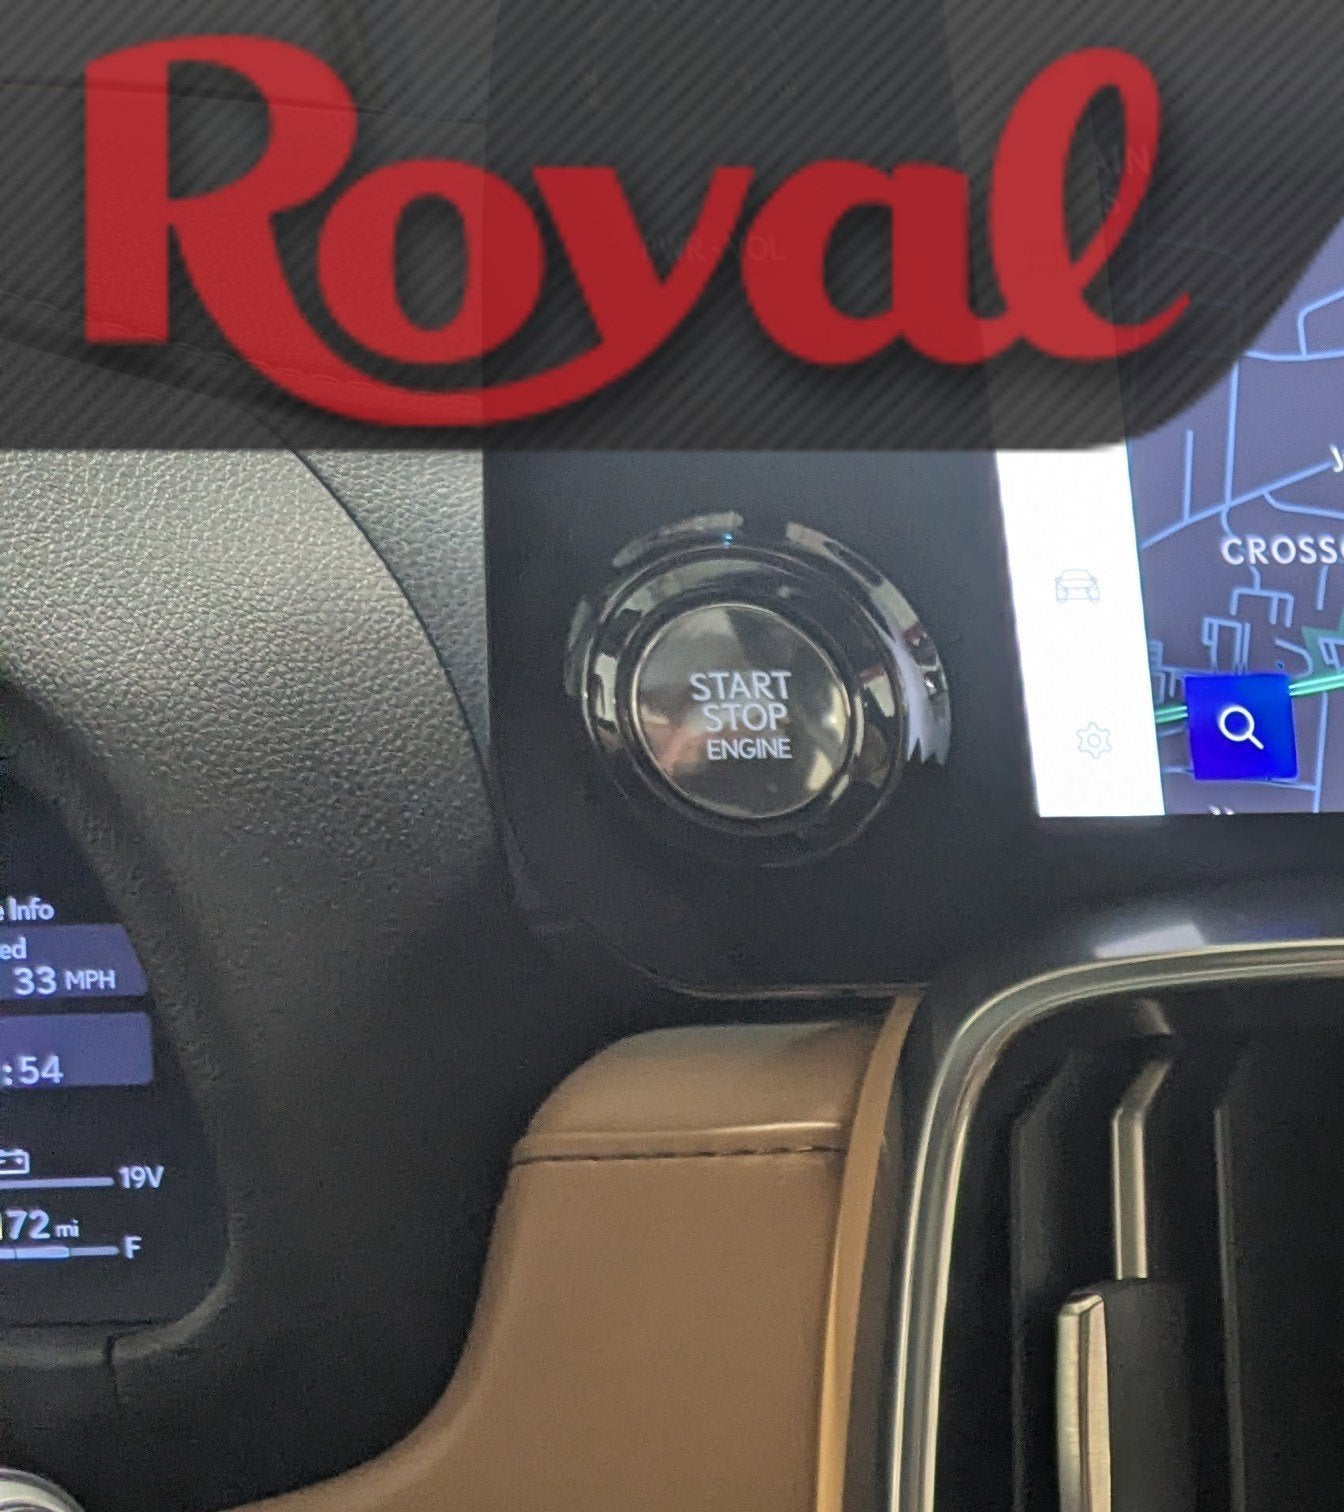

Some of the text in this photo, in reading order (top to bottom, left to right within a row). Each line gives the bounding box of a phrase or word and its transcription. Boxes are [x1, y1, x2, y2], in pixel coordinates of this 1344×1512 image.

[689, 671, 792, 702] START
[702, 703, 788, 733] STOP
[707, 738, 792, 761] ENGINE
[9, 898, 54, 921] Info
[14, 967, 116, 996] 33 MPH
[118, 1166, 164, 1189] 19V
[55, 1219, 79, 1238] mi
[123, 1236, 142, 1259] F
